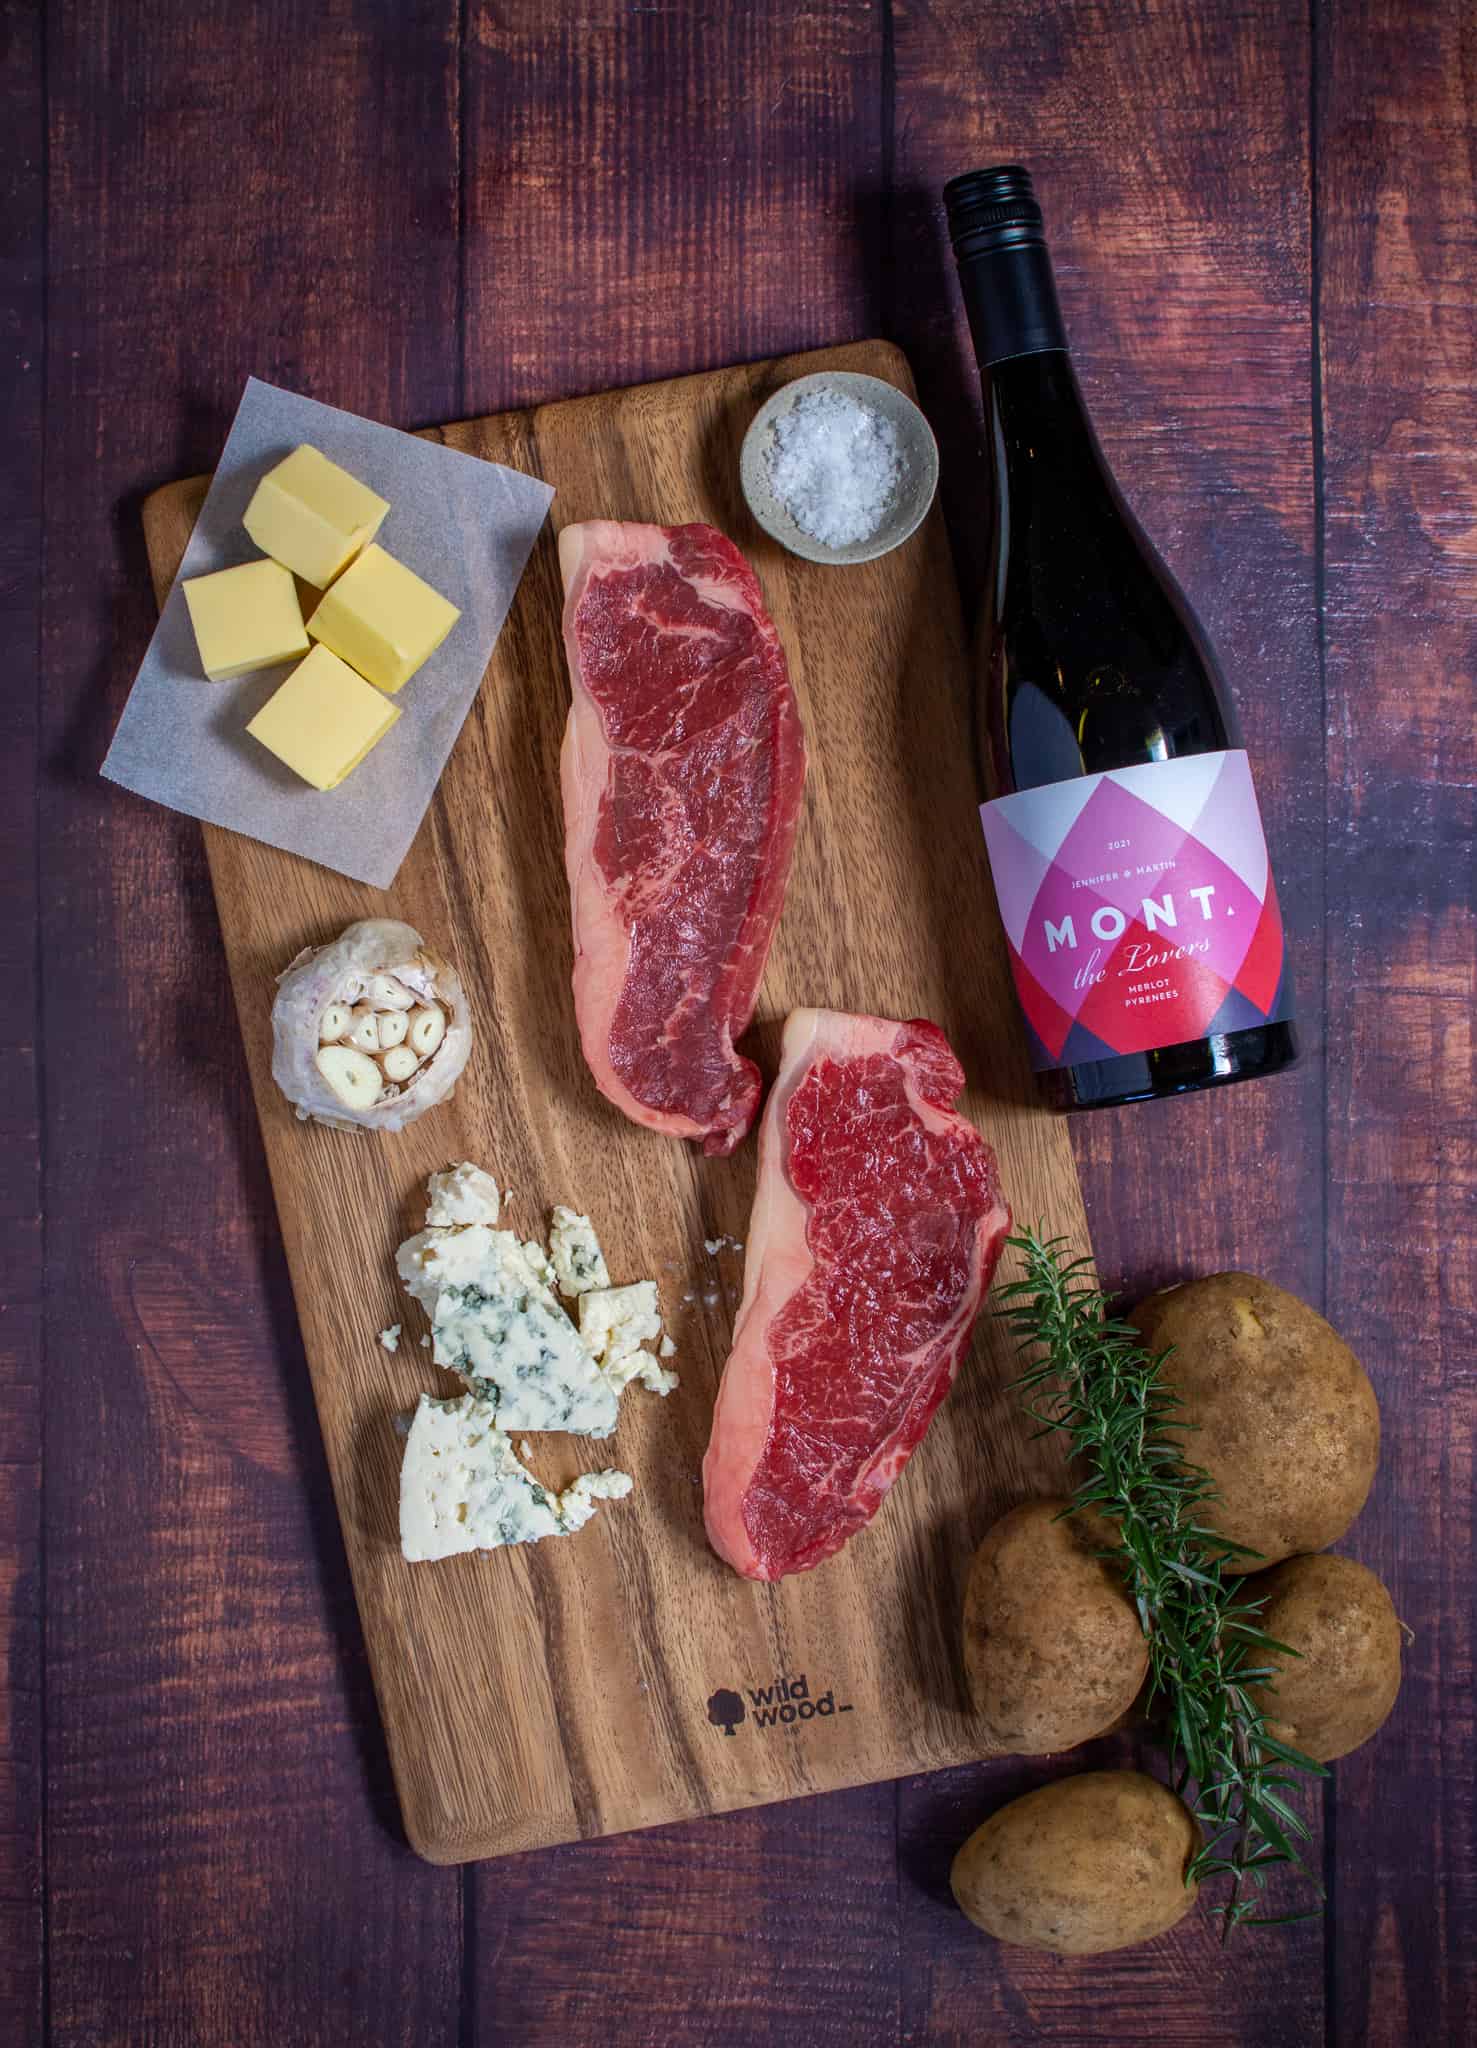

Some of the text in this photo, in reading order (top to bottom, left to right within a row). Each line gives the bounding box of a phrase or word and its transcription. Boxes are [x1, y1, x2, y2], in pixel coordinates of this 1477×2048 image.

[1107, 839, 1131, 850] 2021
[1071, 871, 1120, 889] JENNIFER
[1136, 860, 1177, 875] MARTIN
[1072, 937, 1211, 991] the Lovers
[1128, 978, 1170, 994] MERLOT
[1124, 989, 1180, 1007] PYRENEES
[747, 1674, 809, 1707] wild
